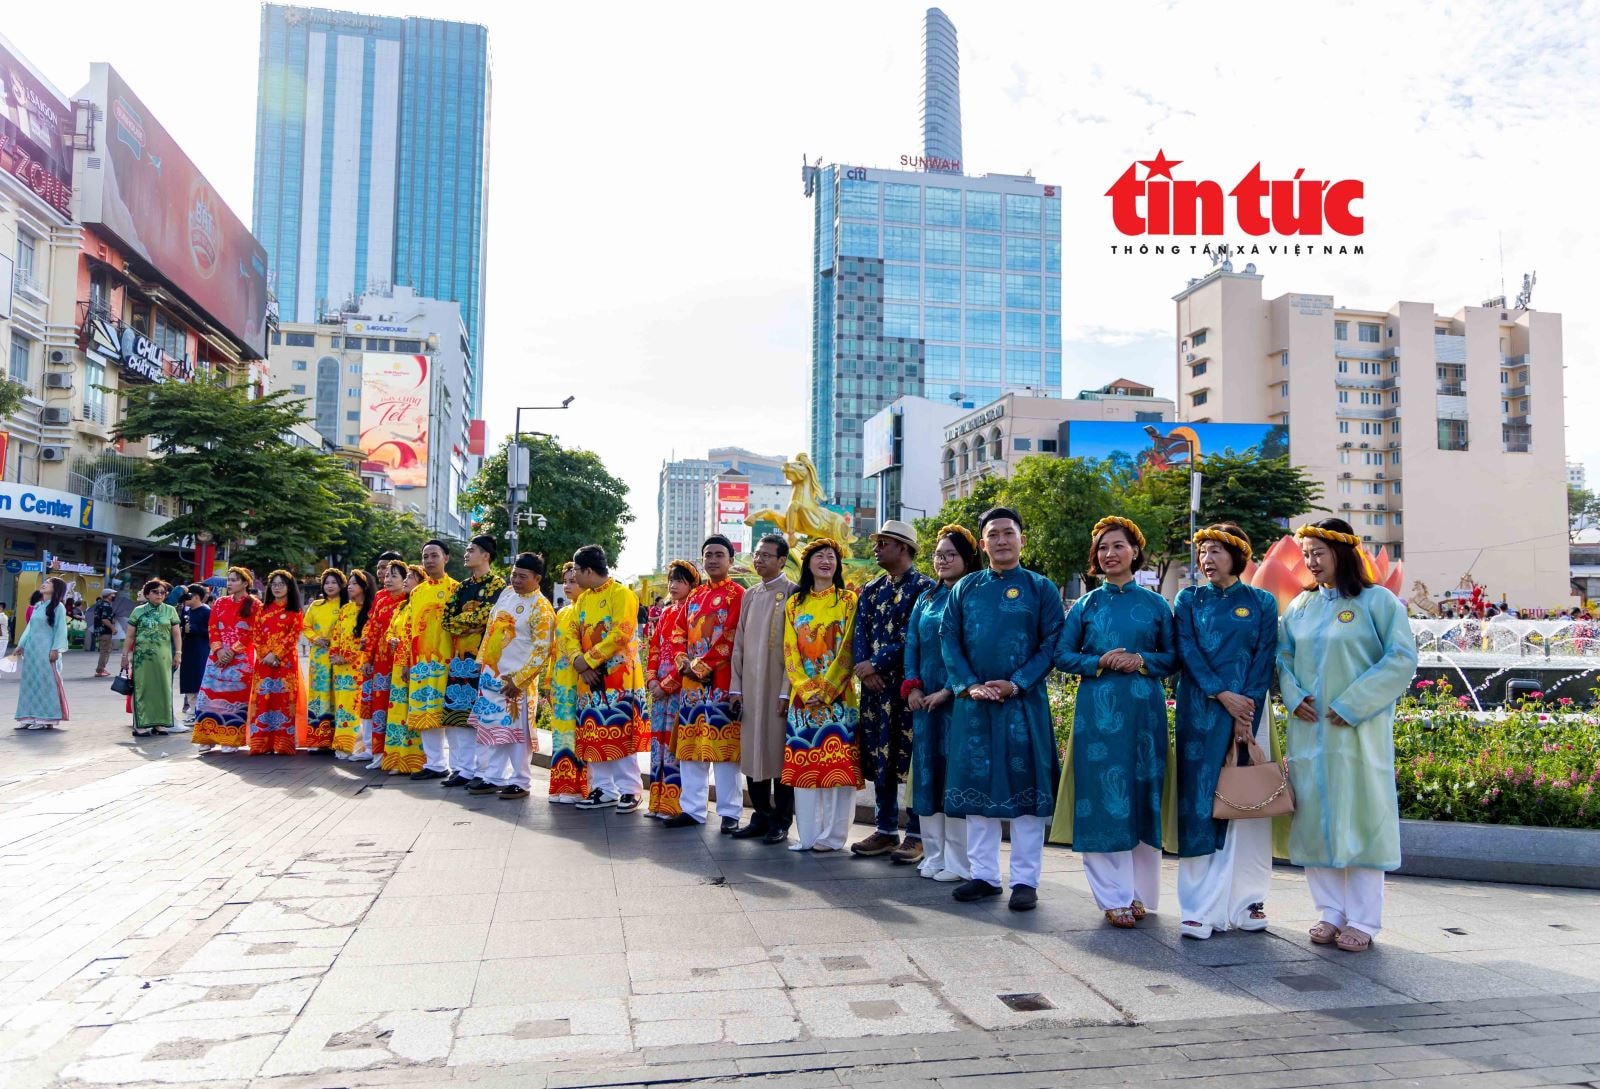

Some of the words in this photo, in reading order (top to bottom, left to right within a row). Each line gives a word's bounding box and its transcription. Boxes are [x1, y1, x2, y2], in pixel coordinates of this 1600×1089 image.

[847, 166, 867, 181] citi
[900, 154, 960, 171] SUNWAH
[15, 144, 73, 217] ZONE
[137, 337, 163, 367] CHILL
[20, 492, 73, 518] Center
